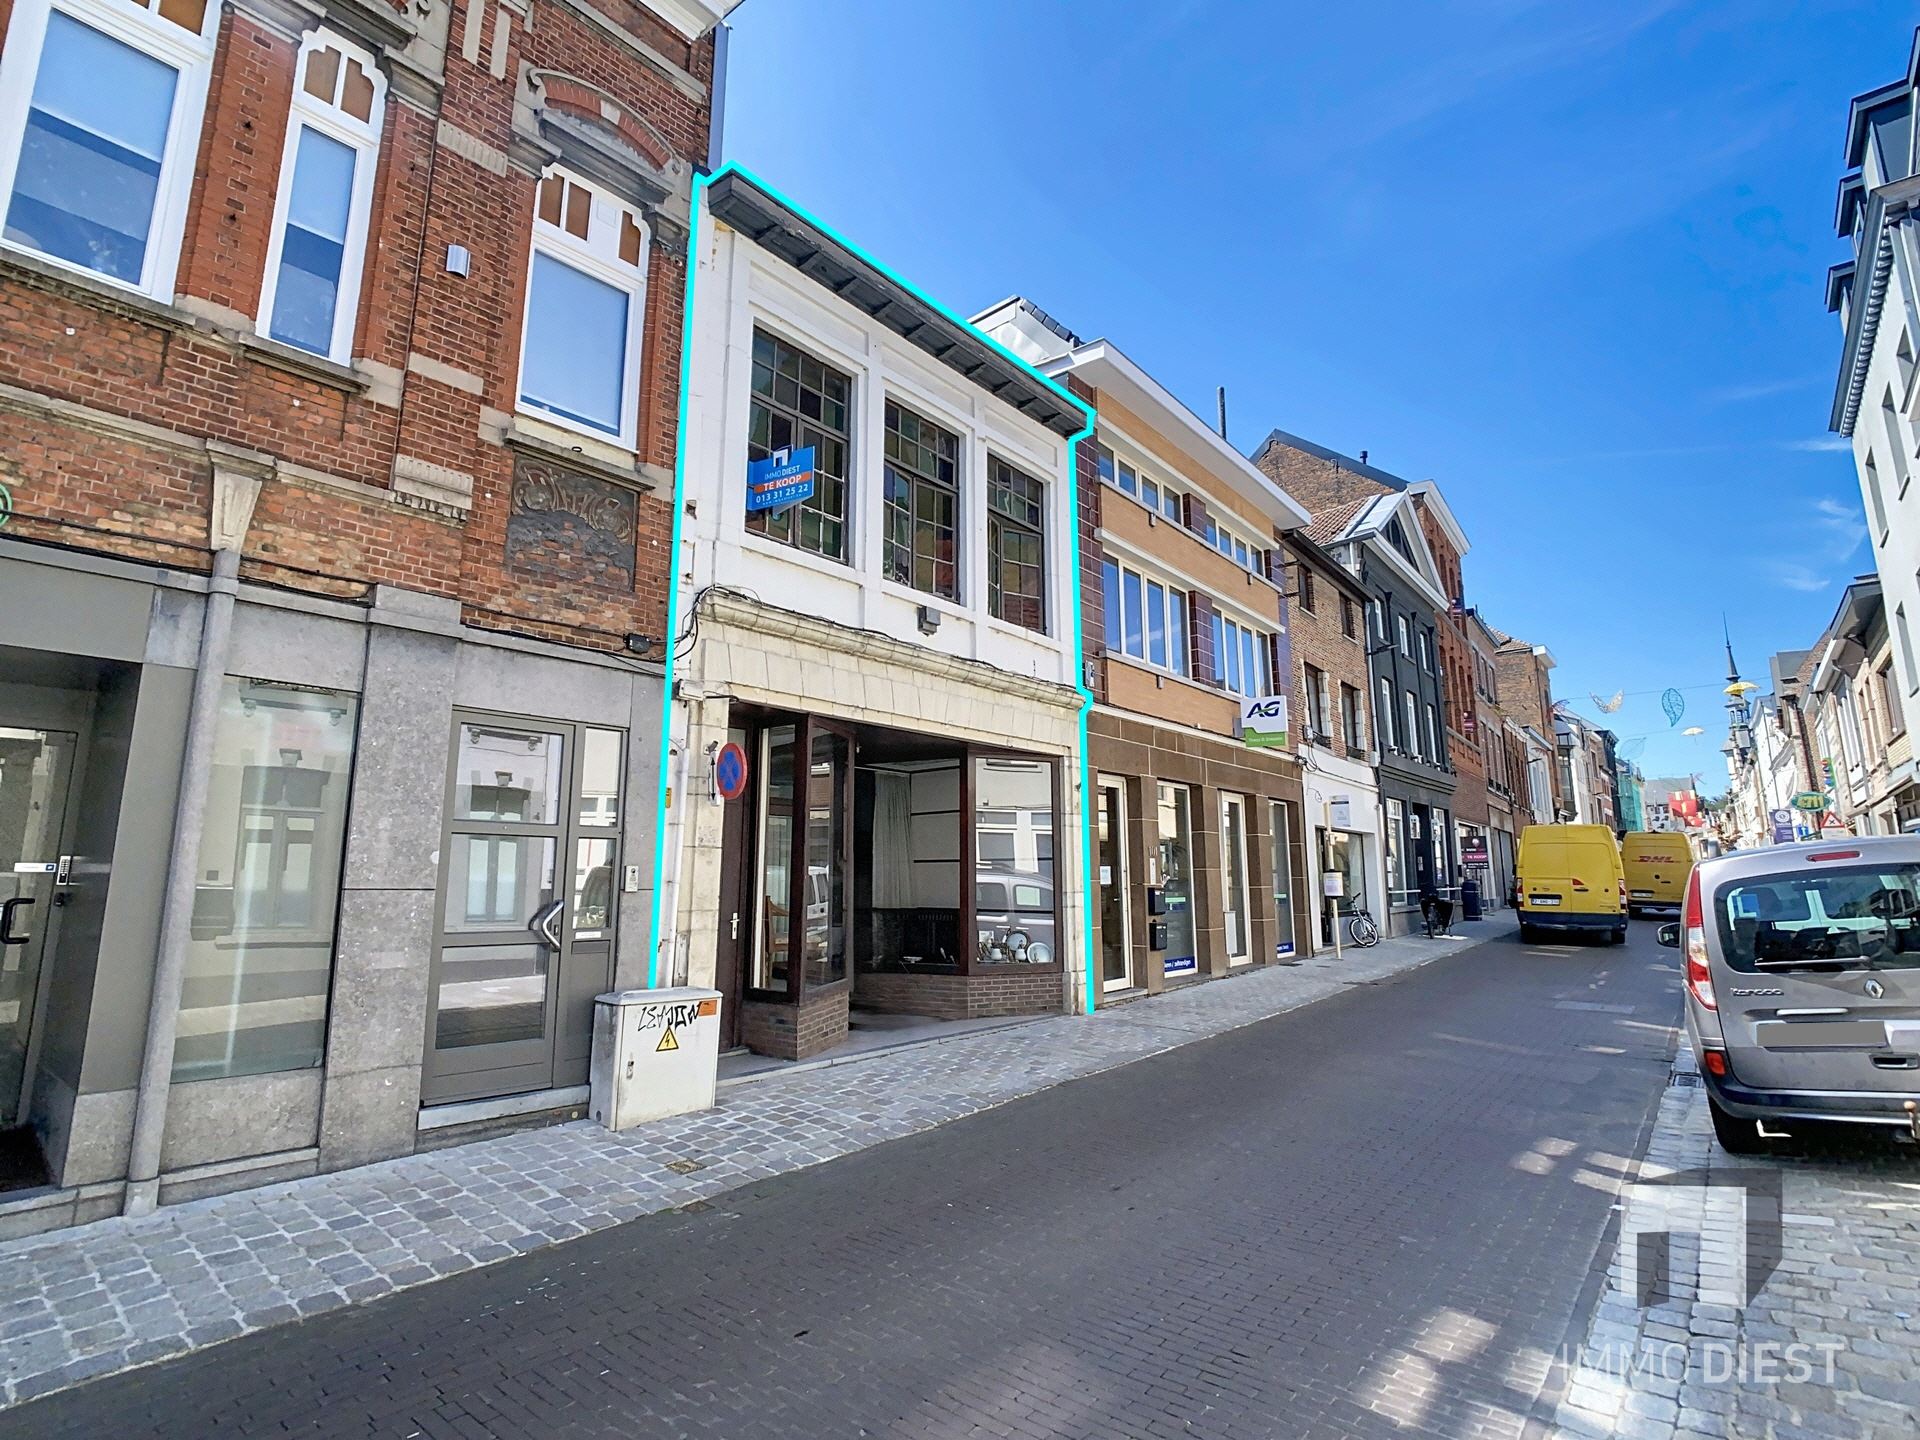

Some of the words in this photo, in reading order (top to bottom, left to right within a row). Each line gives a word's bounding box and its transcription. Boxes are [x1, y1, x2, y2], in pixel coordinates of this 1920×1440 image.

[765, 470, 781, 480] IMMO
[782, 465, 800, 476] DIEST
[763, 481, 775, 491] TE
[776, 475, 802, 488] KOOP
[755, 493, 771, 503] 013
[773, 490, 783, 499] 31
[785, 487, 796, 496] 25
[797, 483, 808, 493] 22
[1246, 701, 1280, 718] AG
[1638, 855, 1674, 863] DHL
